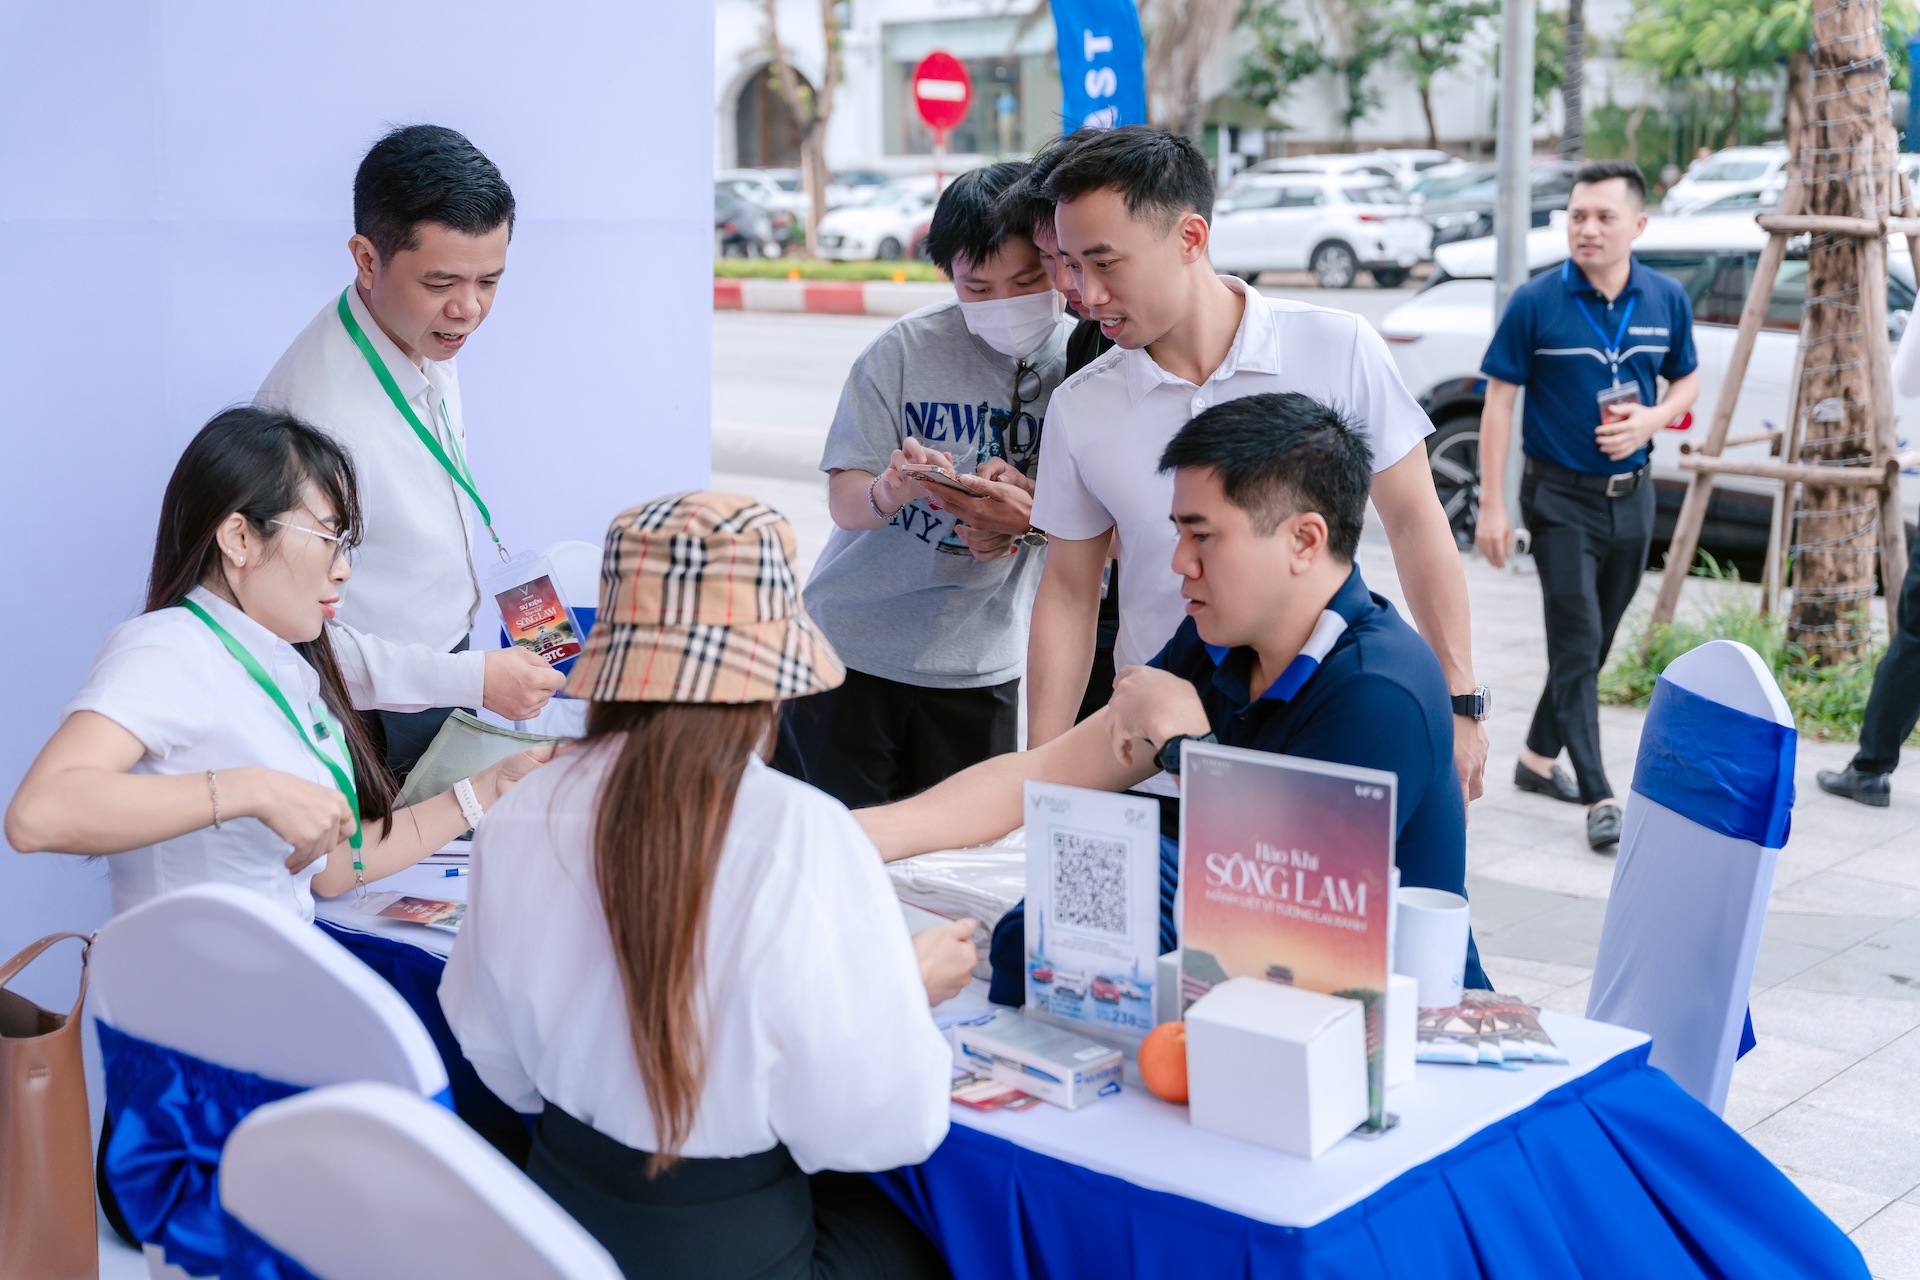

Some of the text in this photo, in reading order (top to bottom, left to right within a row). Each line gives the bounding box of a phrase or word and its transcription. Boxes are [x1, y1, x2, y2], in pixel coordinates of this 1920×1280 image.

[905, 402, 980, 444] NEW
[543, 647, 565, 662] BTC
[1255, 841, 1289, 864] Hào
[1205, 852, 1367, 916] SÔNG LAM
